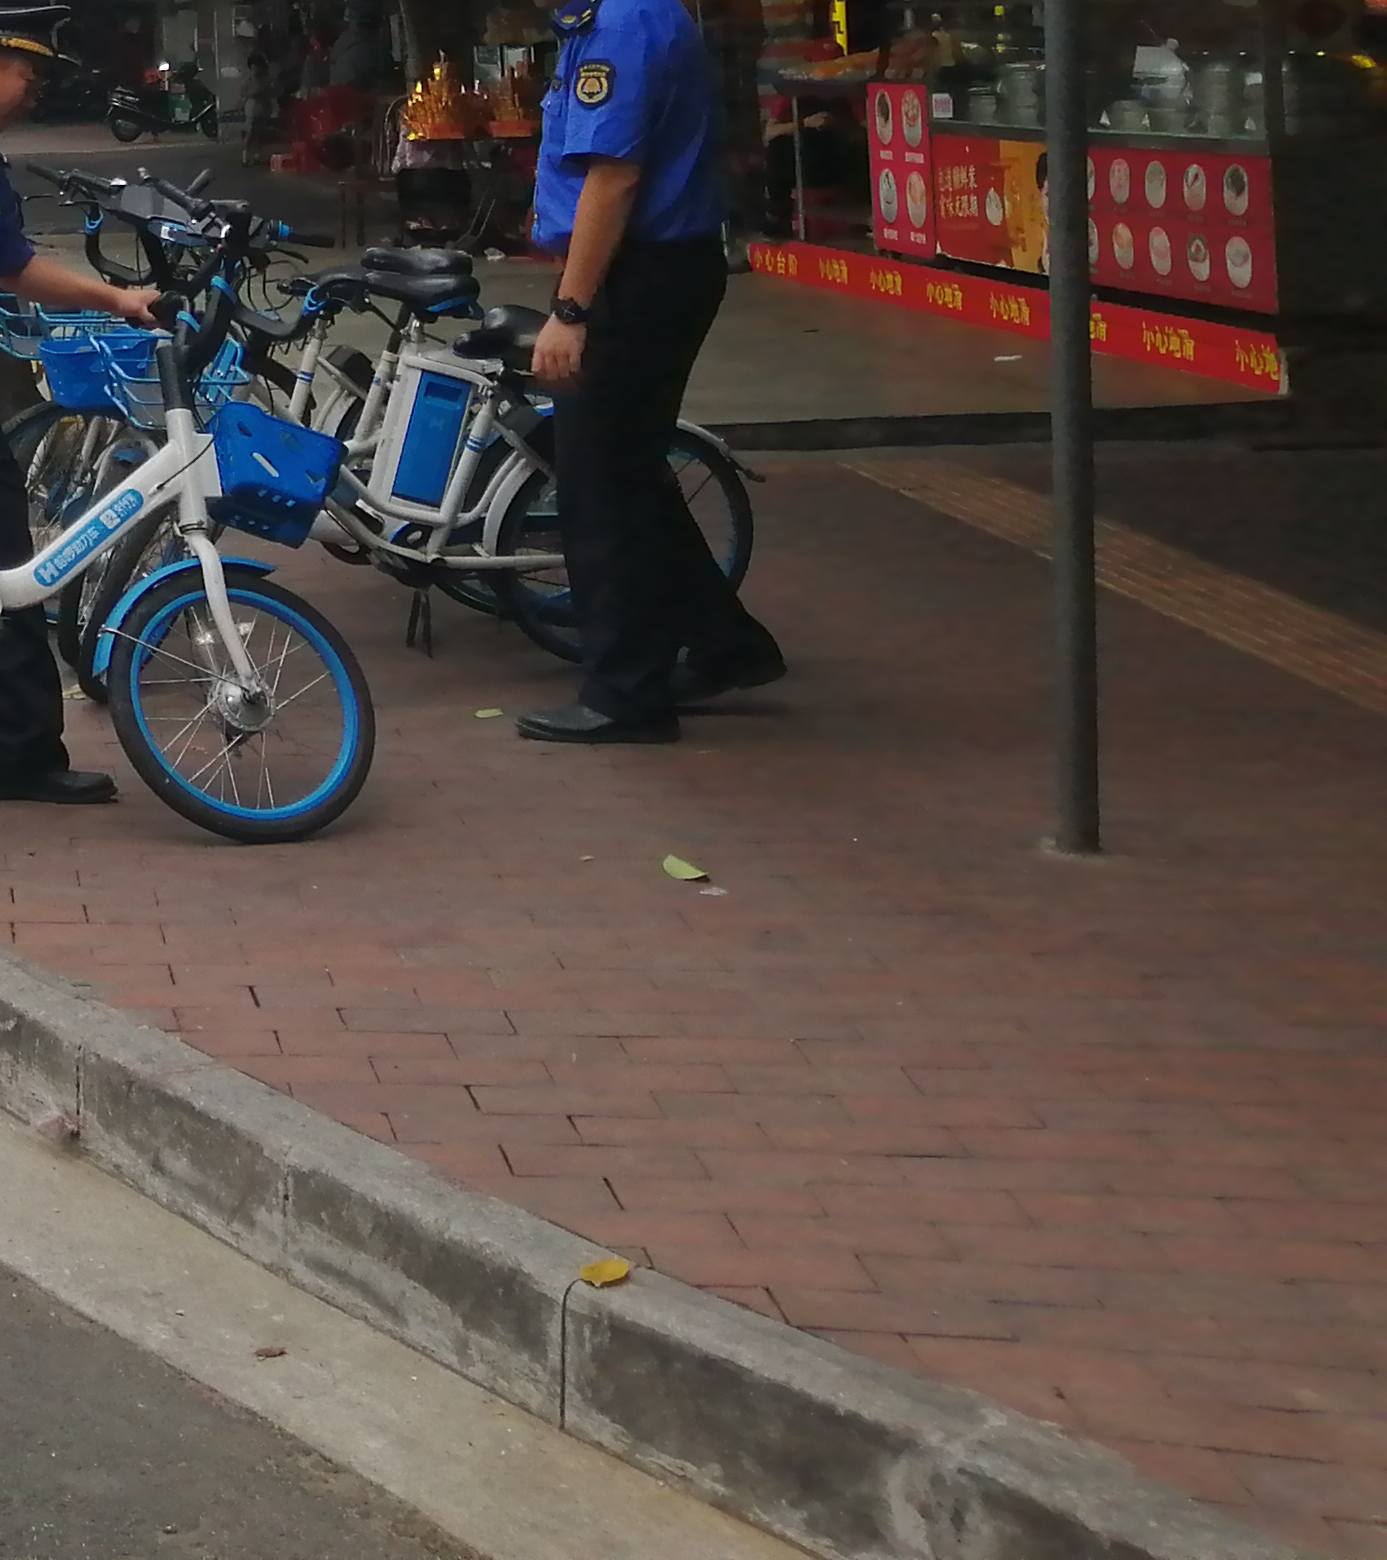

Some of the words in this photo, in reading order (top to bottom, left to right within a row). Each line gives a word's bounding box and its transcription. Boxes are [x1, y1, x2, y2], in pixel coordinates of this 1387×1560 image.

[990, 292, 1030, 326] 小心地滑
[1142, 321, 1195, 361] 小心地滑
